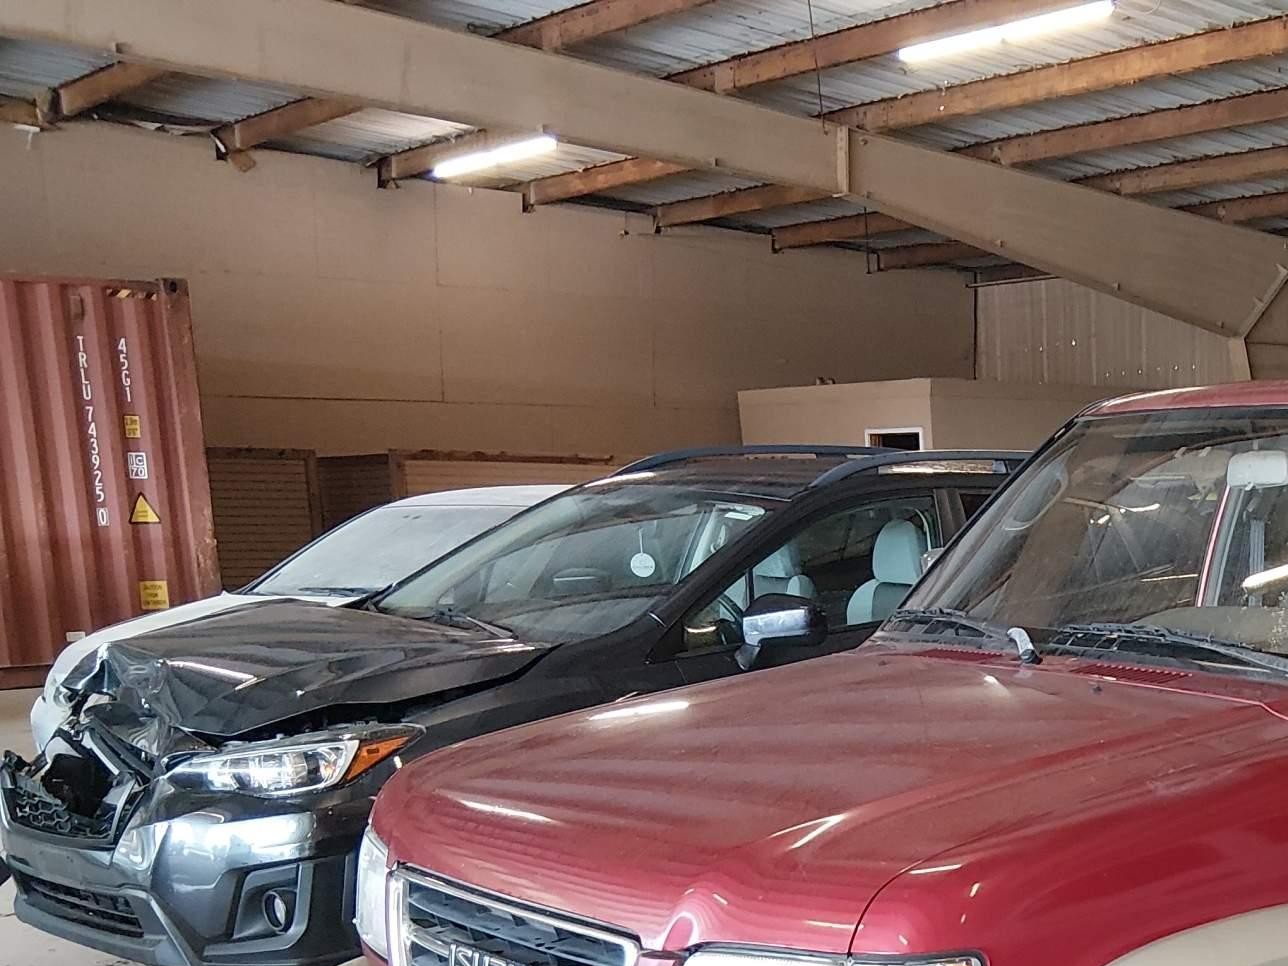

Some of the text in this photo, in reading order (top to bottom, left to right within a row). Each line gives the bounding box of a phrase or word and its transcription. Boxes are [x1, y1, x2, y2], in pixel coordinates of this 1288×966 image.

[76, 335, 92, 401] TRLU
[84, 405, 105, 503] 743925
[117, 337, 133, 403] 45G1
